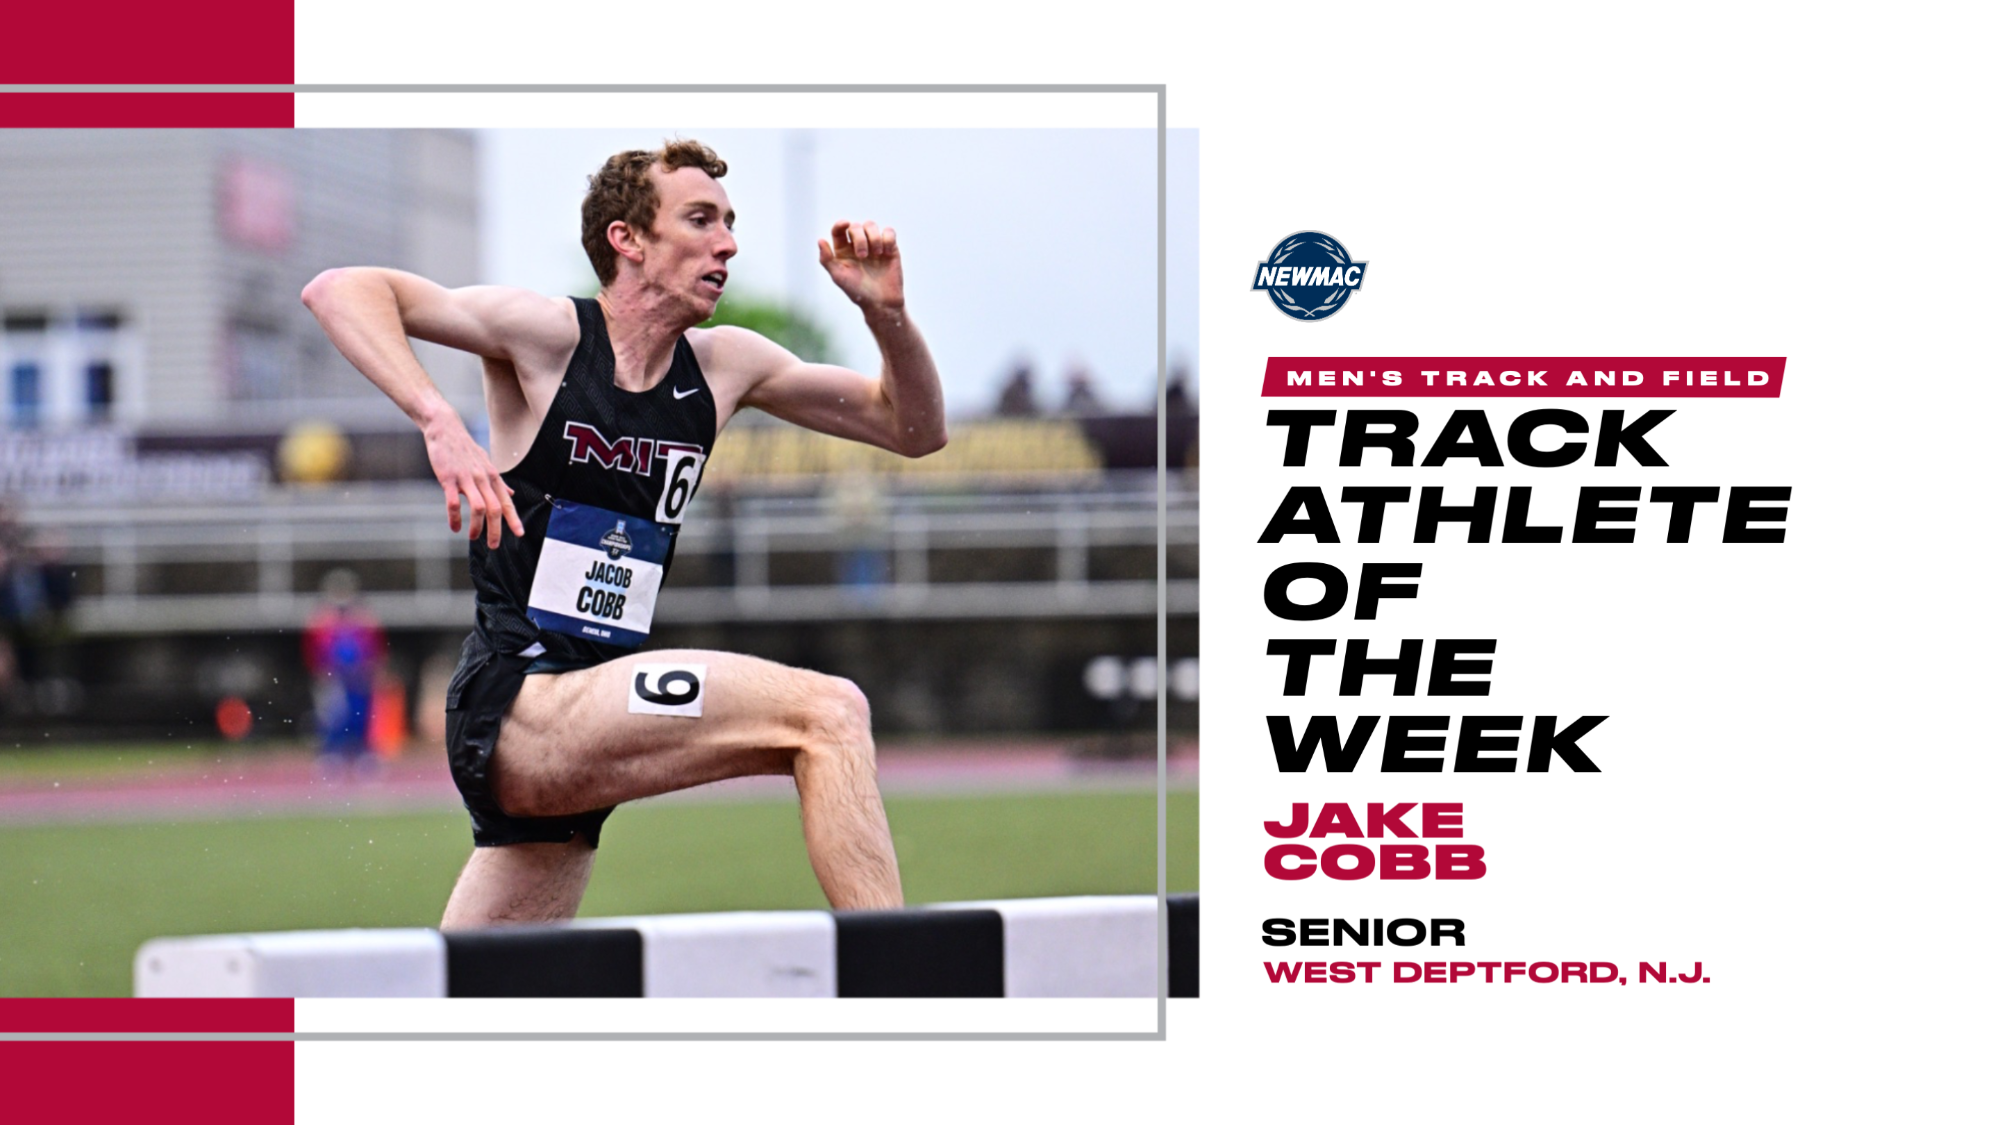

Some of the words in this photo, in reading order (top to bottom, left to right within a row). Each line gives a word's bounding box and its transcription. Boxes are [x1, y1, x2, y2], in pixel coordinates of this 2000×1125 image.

[664, 455, 697, 519] 6
[585, 560, 633, 589] JACOB
[576, 585, 627, 621] COBB
